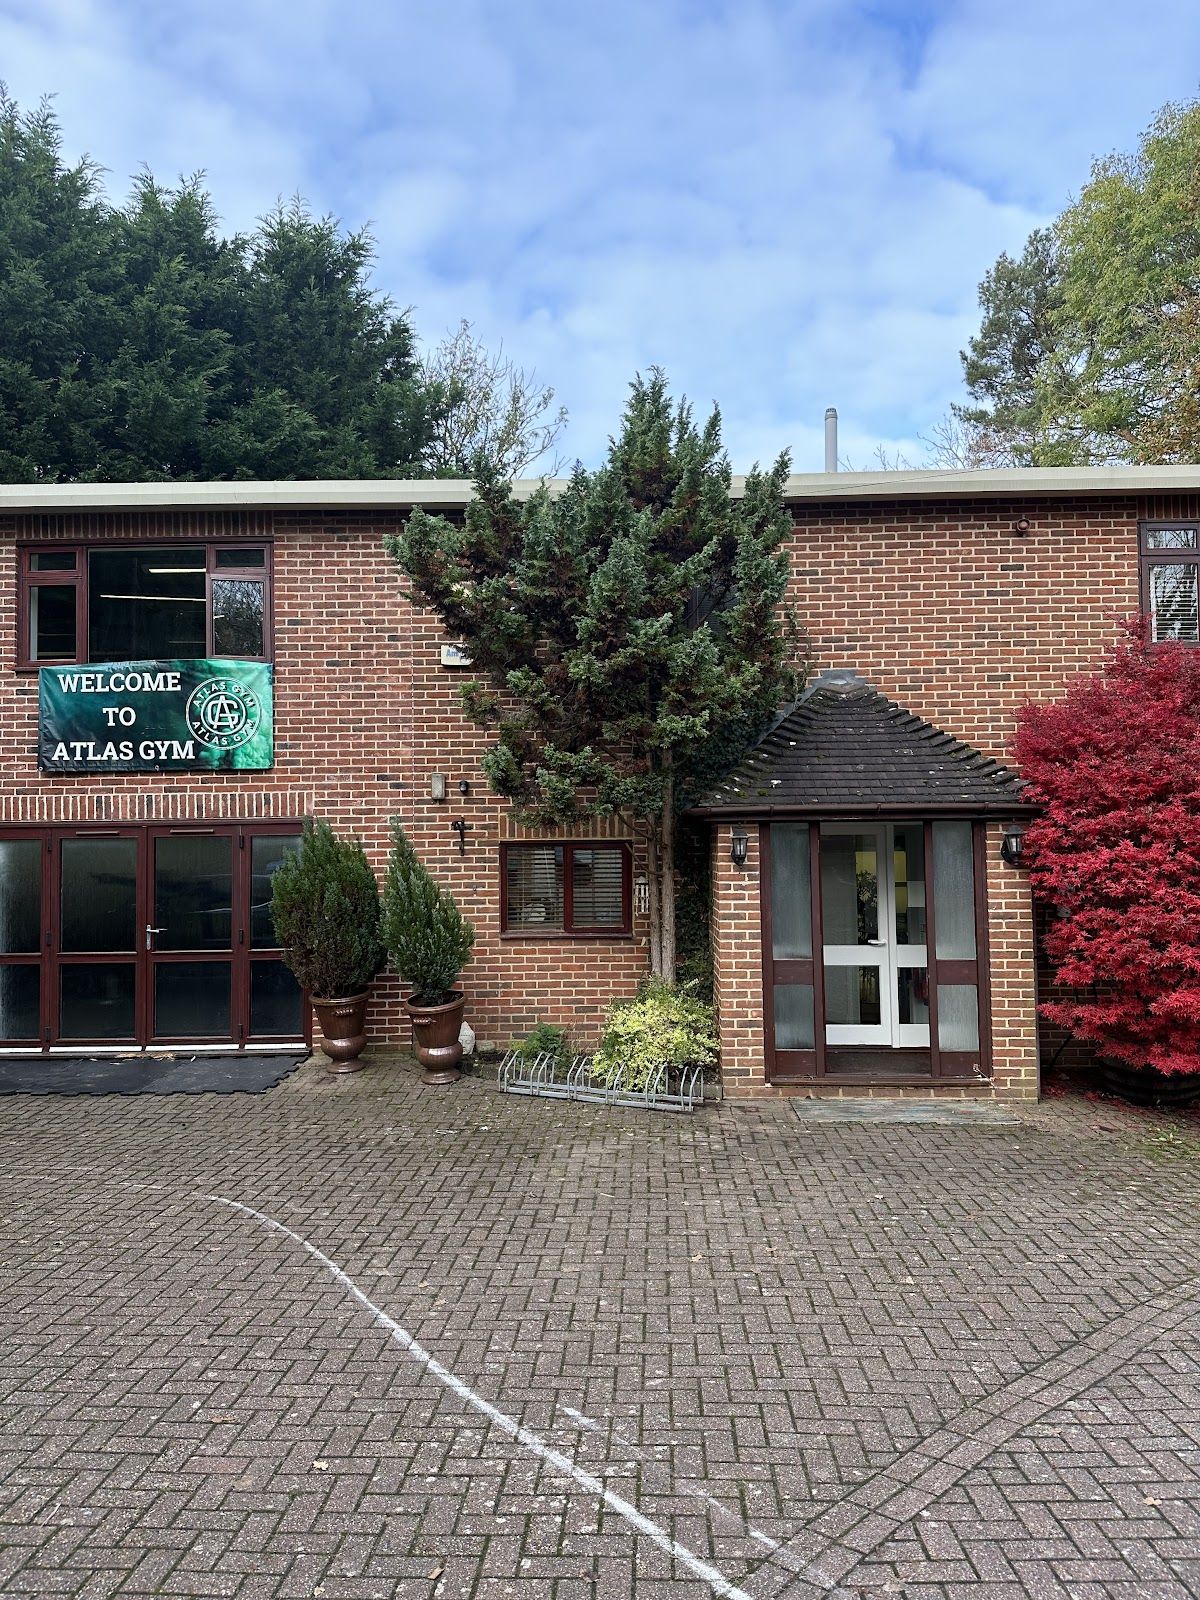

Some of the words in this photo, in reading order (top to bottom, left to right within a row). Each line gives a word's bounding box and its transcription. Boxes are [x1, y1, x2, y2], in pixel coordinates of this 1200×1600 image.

[57, 672, 182, 693] WELCOME
[193, 682, 226, 708] ATLAS
[232, 685, 256, 707] GYM
[103, 707, 136, 727] TO
[192, 721, 228, 745] ATLAS
[233, 719, 255, 742] GYM
[51, 741, 134, 761] ATLAS
[138, 740, 196, 760] GYM
